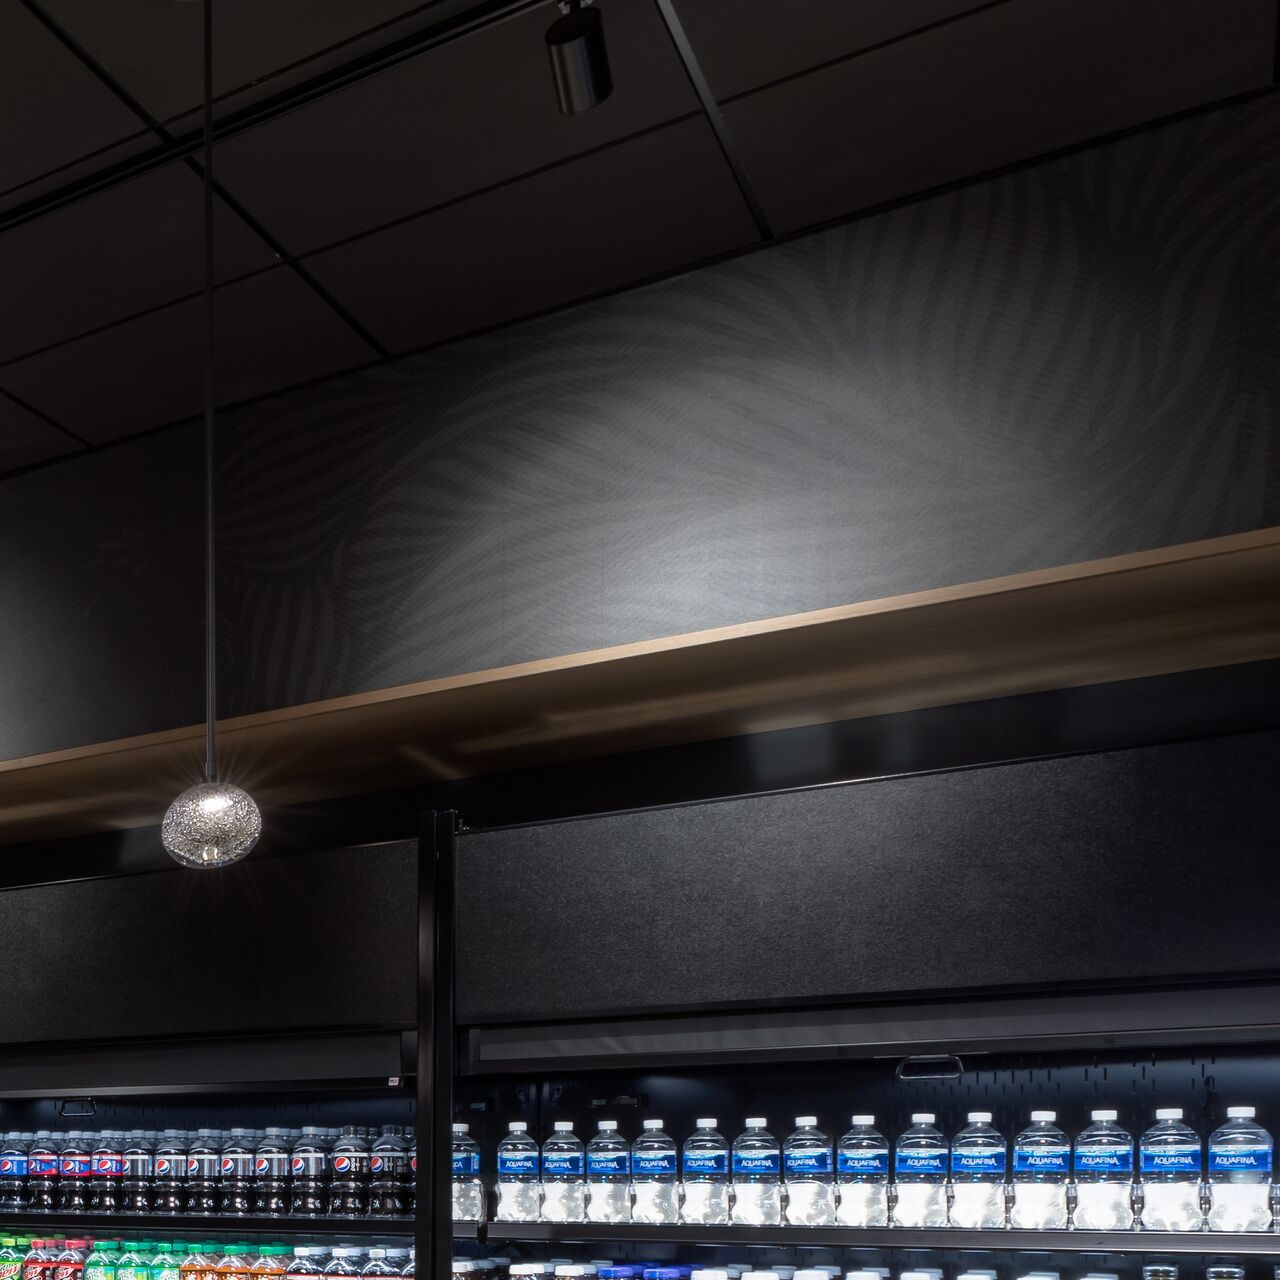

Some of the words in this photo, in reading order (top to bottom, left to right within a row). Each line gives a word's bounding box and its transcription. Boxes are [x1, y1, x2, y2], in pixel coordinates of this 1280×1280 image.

[506, 1160, 533, 1168] AQUAFINA
[544, 1160, 572, 1169] AQUAFINA
[590, 1160, 619, 1169] AQUAFINA
[639, 1159, 668, 1168] AQUAFINA
[686, 1159, 717, 1168] AQUAFINA
[741, 1158, 773, 1167] AQUAFINA
[787, 1158, 818, 1167] AQUAFINA
[847, 1158, 880, 1167] AQUAFINA
[906, 1158, 941, 1167] AQUAFINA
[960, 1157, 997, 1166] AQUAFINA
[1027, 1156, 1064, 1165] AQUAFINA
[1081, 1156, 1119, 1165] AQUAFINA
[1154, 1156, 1193, 1165] AQUAFINA
[1215, 1156, 1257, 1165] AQUAFINA
